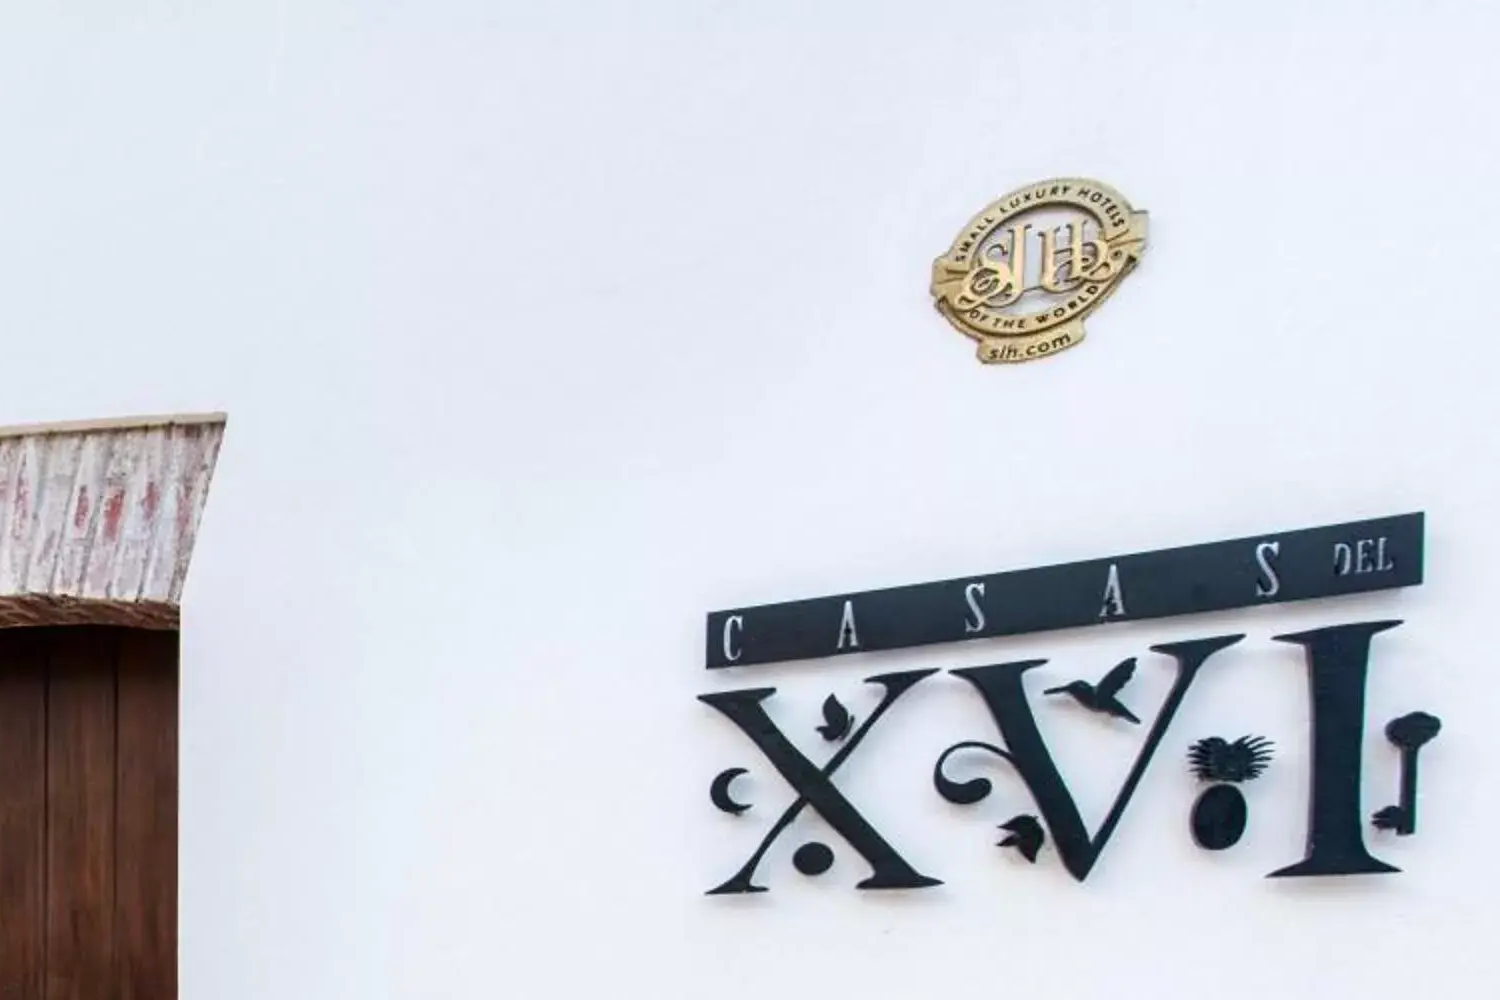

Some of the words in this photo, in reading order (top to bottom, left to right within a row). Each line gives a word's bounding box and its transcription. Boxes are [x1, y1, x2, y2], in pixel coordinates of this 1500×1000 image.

[955, 215, 995, 263] SMALL
[999, 184, 1071, 214] LUXURY
[1077, 186, 1126, 229] HOTELS
[969, 308, 989, 322] OF
[992, 317, 1027, 329] THE
[1035, 285, 1100, 324] WORLD
[989, 332, 1072, 361] slh.com
[722, 540, 1281, 662] CASAS
[1333, 536, 1395, 576] DEL
[696, 619, 1405, 896] XVI
